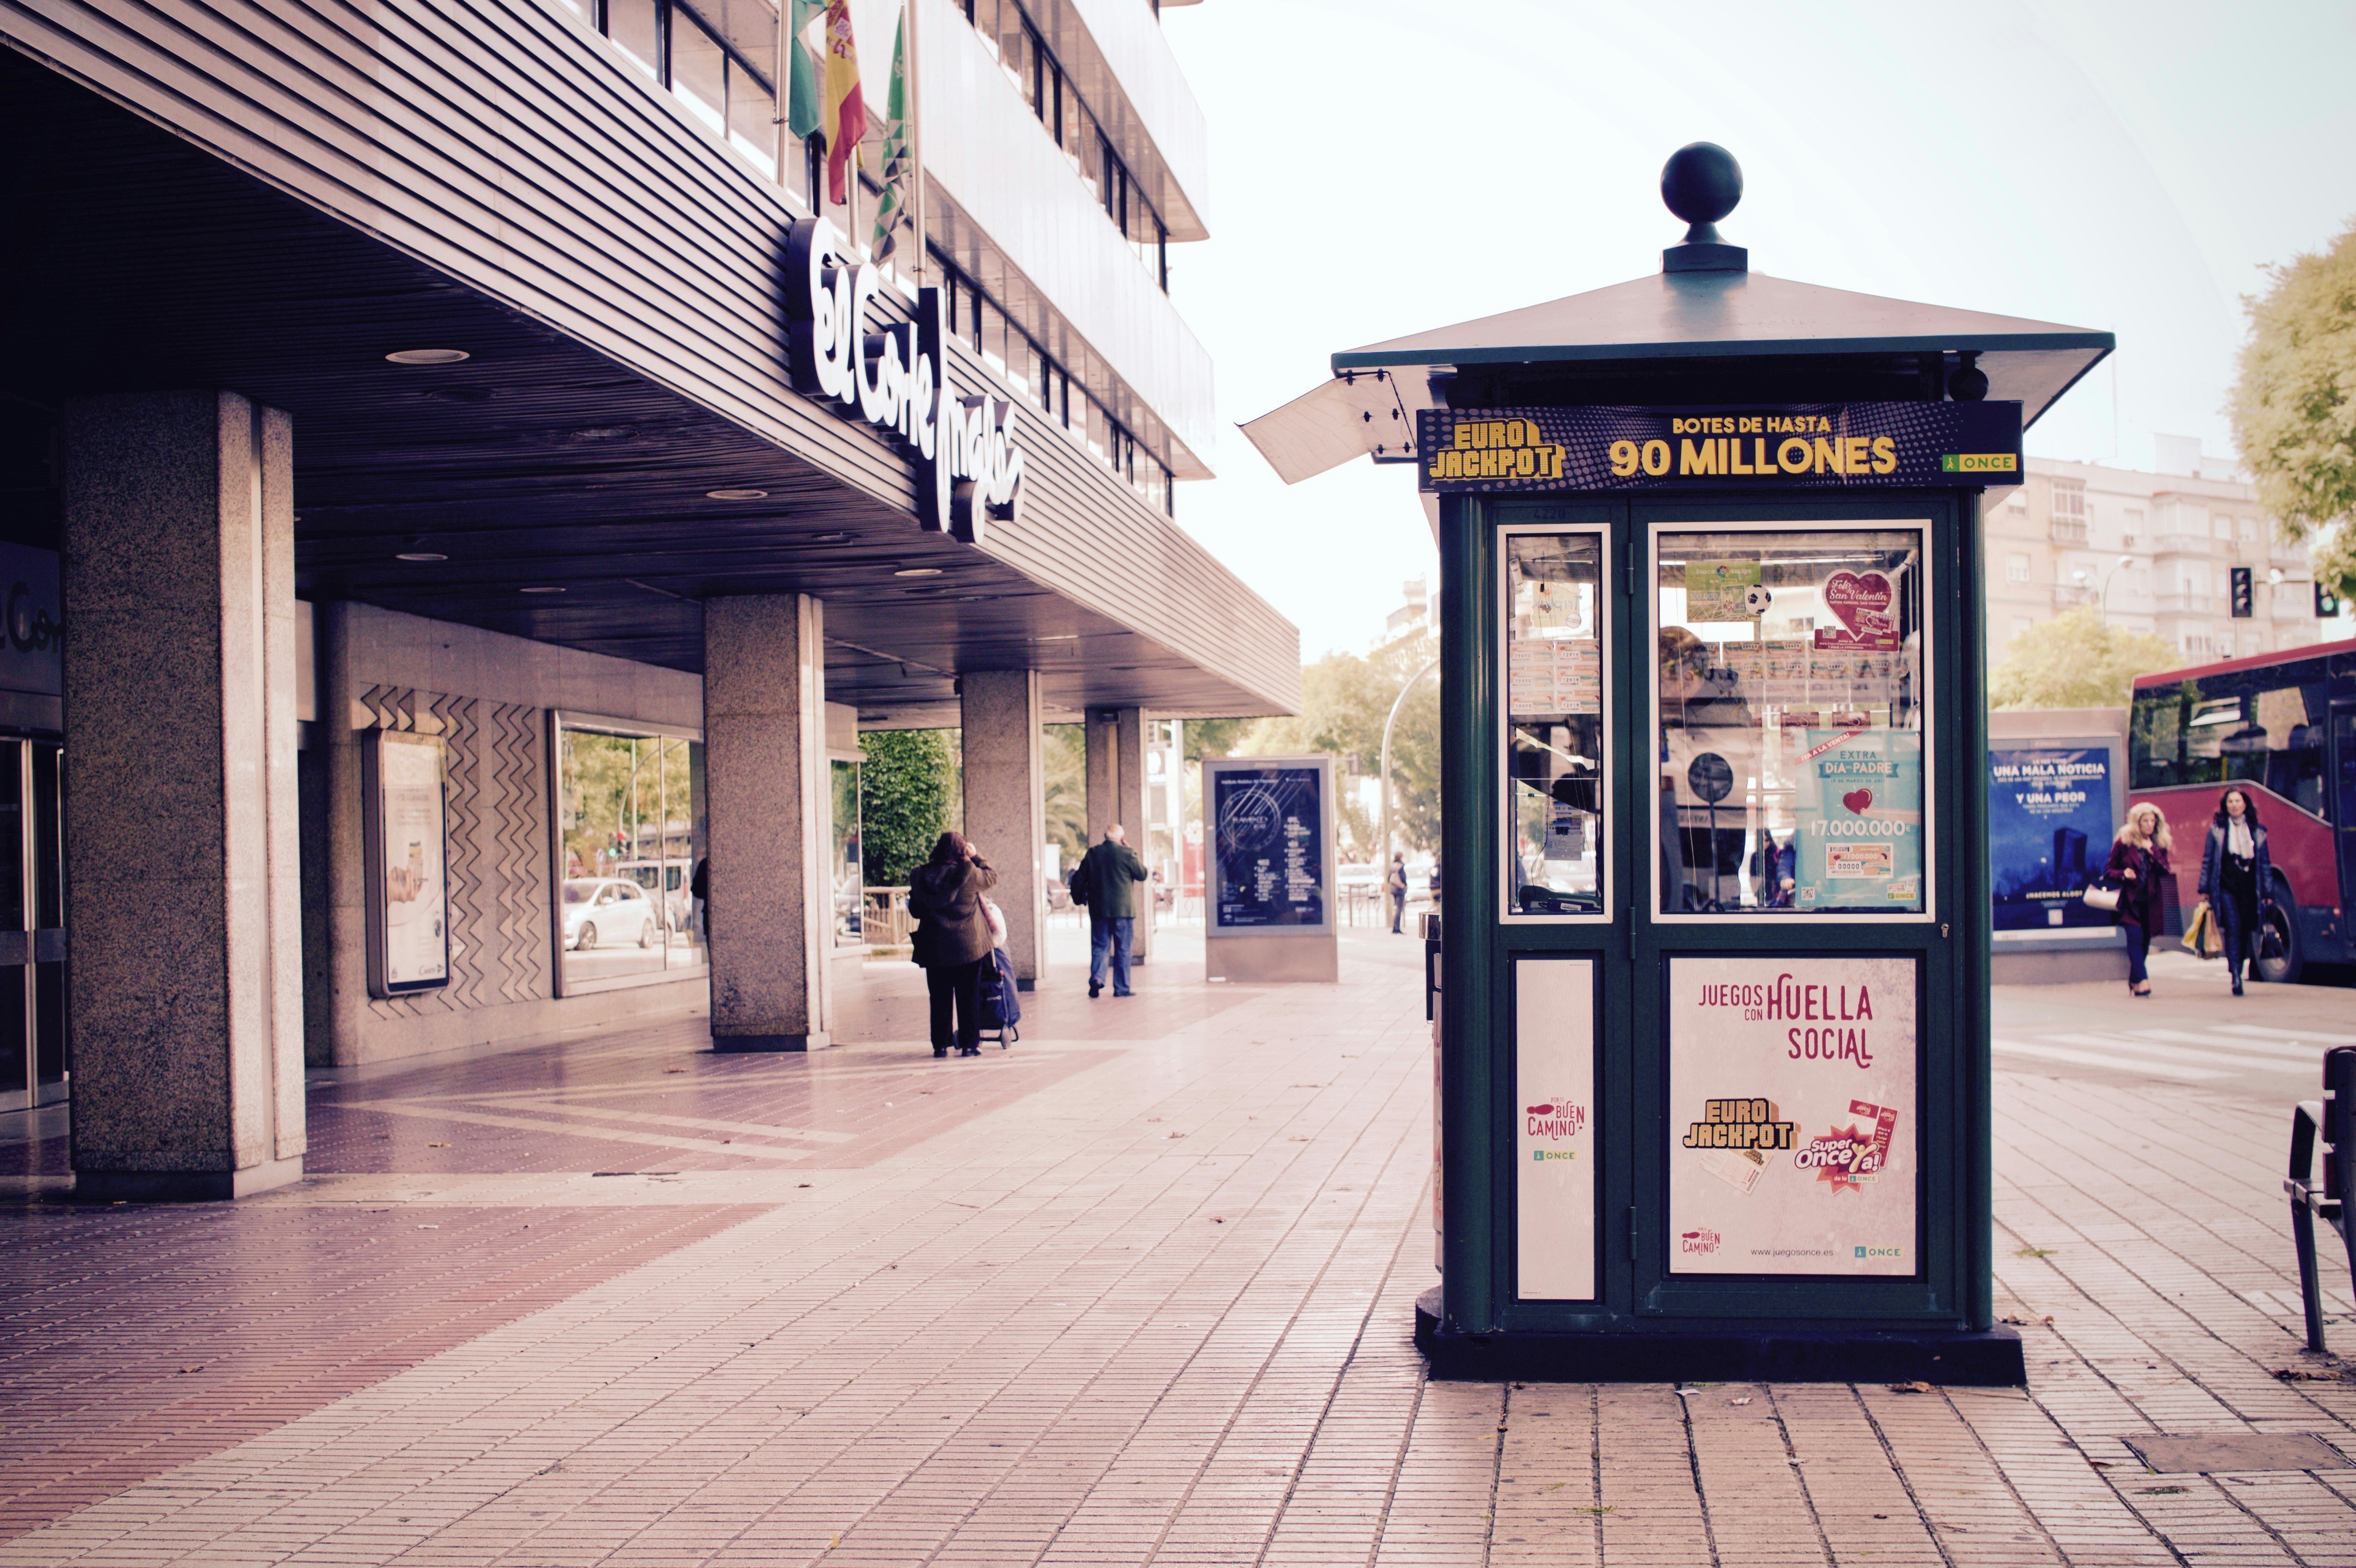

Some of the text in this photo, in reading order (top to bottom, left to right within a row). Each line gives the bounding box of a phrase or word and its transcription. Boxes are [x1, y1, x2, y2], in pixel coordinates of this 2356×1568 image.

[810, 216, 854, 404] El
[853, 263, 934, 460] Corte
[1673, 416, 1831, 434] BOTES DE HASTA
[1454, 421, 1524, 449] EURO
[1429, 447, 1553, 478] JACKPOT
[1609, 436, 1897, 476] 90 MILLONES
[1964, 457, 2013, 469] ONCE
[1829, 589, 1848, 599] San
[1831, 579, 1853, 593] Feliz
[1840, 751, 1877, 759] EXTRA
[1853, 762, 1892, 773] PADRE
[1993, 763, 2106, 777] UNA MALA NOTICIA
[2015, 791, 2086, 804] Y UNA PEOR
[1698, 973, 1873, 1020] JUEGOS HUELLA
[1745, 1009, 1763, 1021] CON
[1788, 1027, 1873, 1069] SOCIAL
[1556, 1101, 1585, 1123] BUEN
[1706, 1100, 1766, 1123] EURO
[1528, 1116, 1575, 1140] CAMINO
[1683, 1123, 1791, 1147] JACKPOT
[1811, 1139, 1853, 1152] Super
[1795, 1148, 1853, 1168] Once
[1701, 1229, 1720, 1244] BUEN
[1683, 1240, 1714, 1256] CAMINO
[1750, 1248, 1834, 1257] www.juegosonce.es
[1869, 1248, 1901, 1256] ONCE
